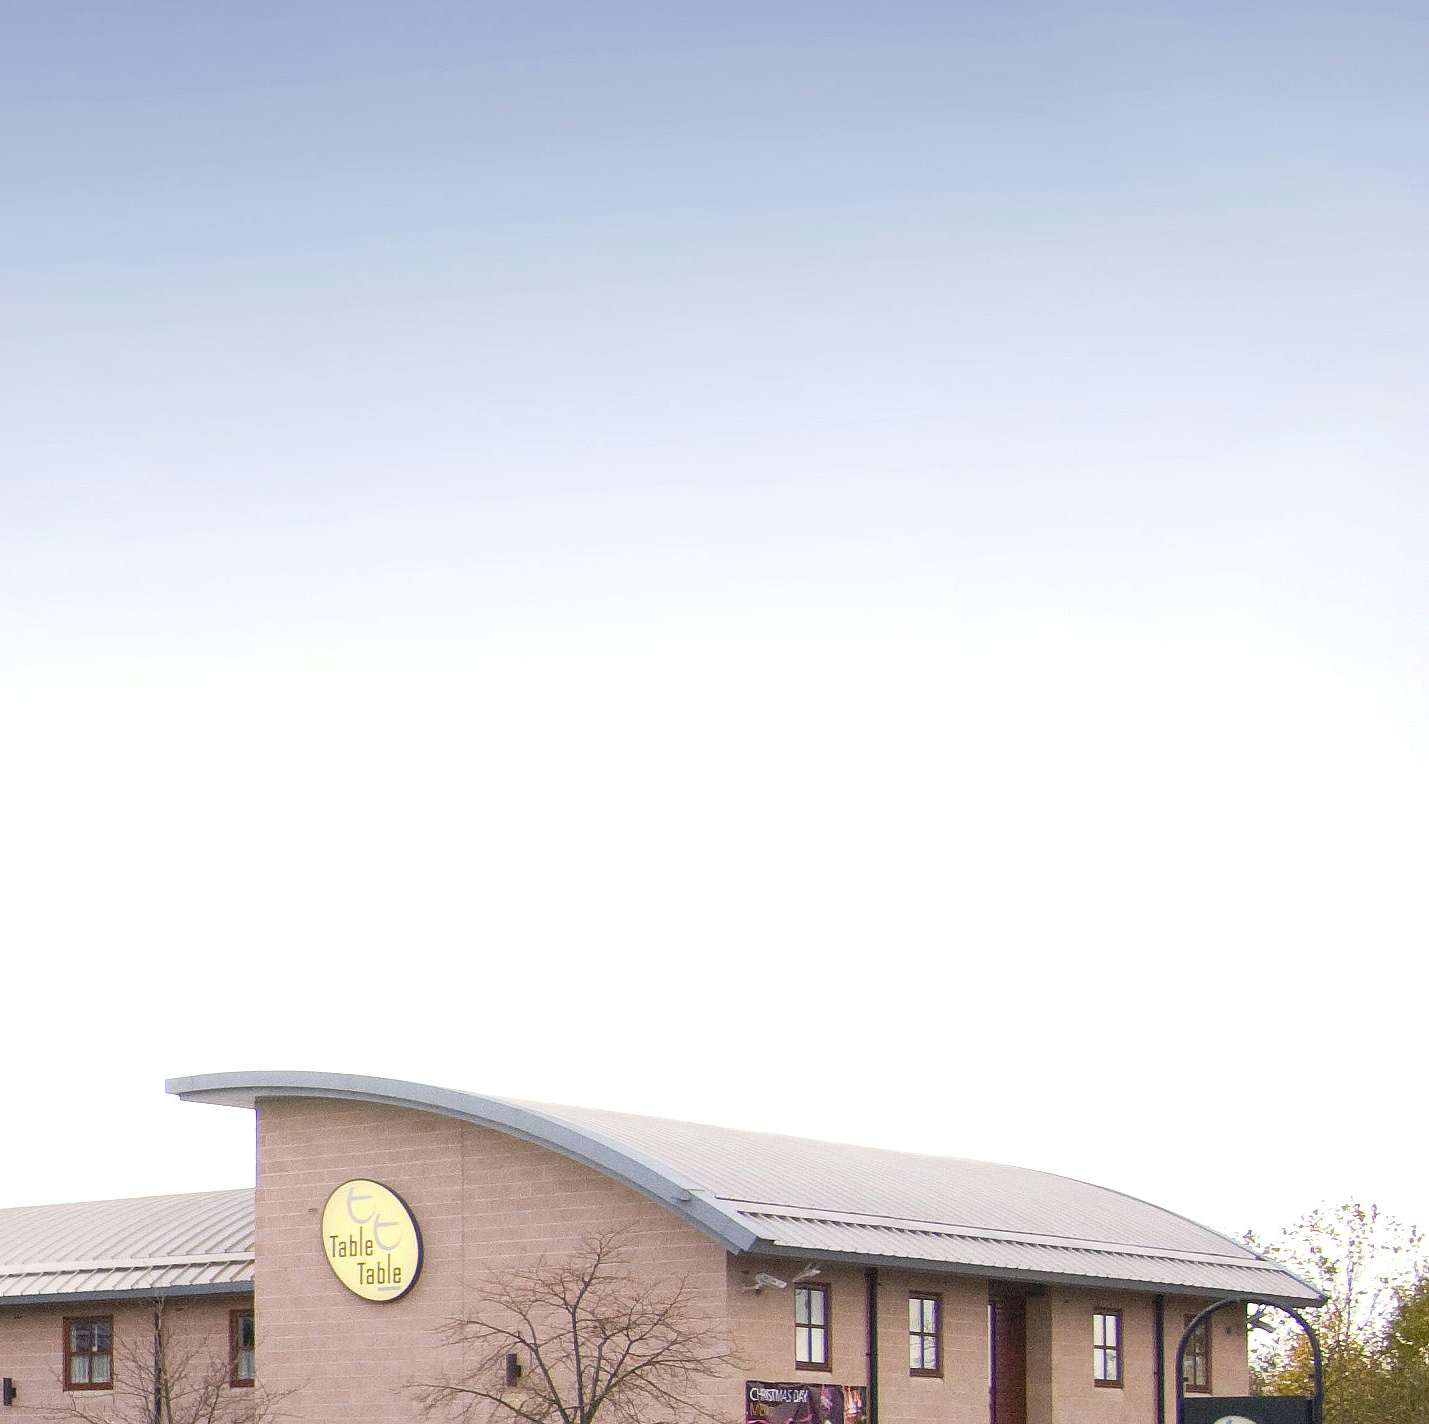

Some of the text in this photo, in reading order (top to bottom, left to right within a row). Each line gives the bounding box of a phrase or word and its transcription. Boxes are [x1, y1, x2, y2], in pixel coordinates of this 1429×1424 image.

[330, 1226, 373, 1257] Table
[357, 1254, 401, 1285] Table
[750, 1387, 809, 1403] CHRISTMAS DAY
